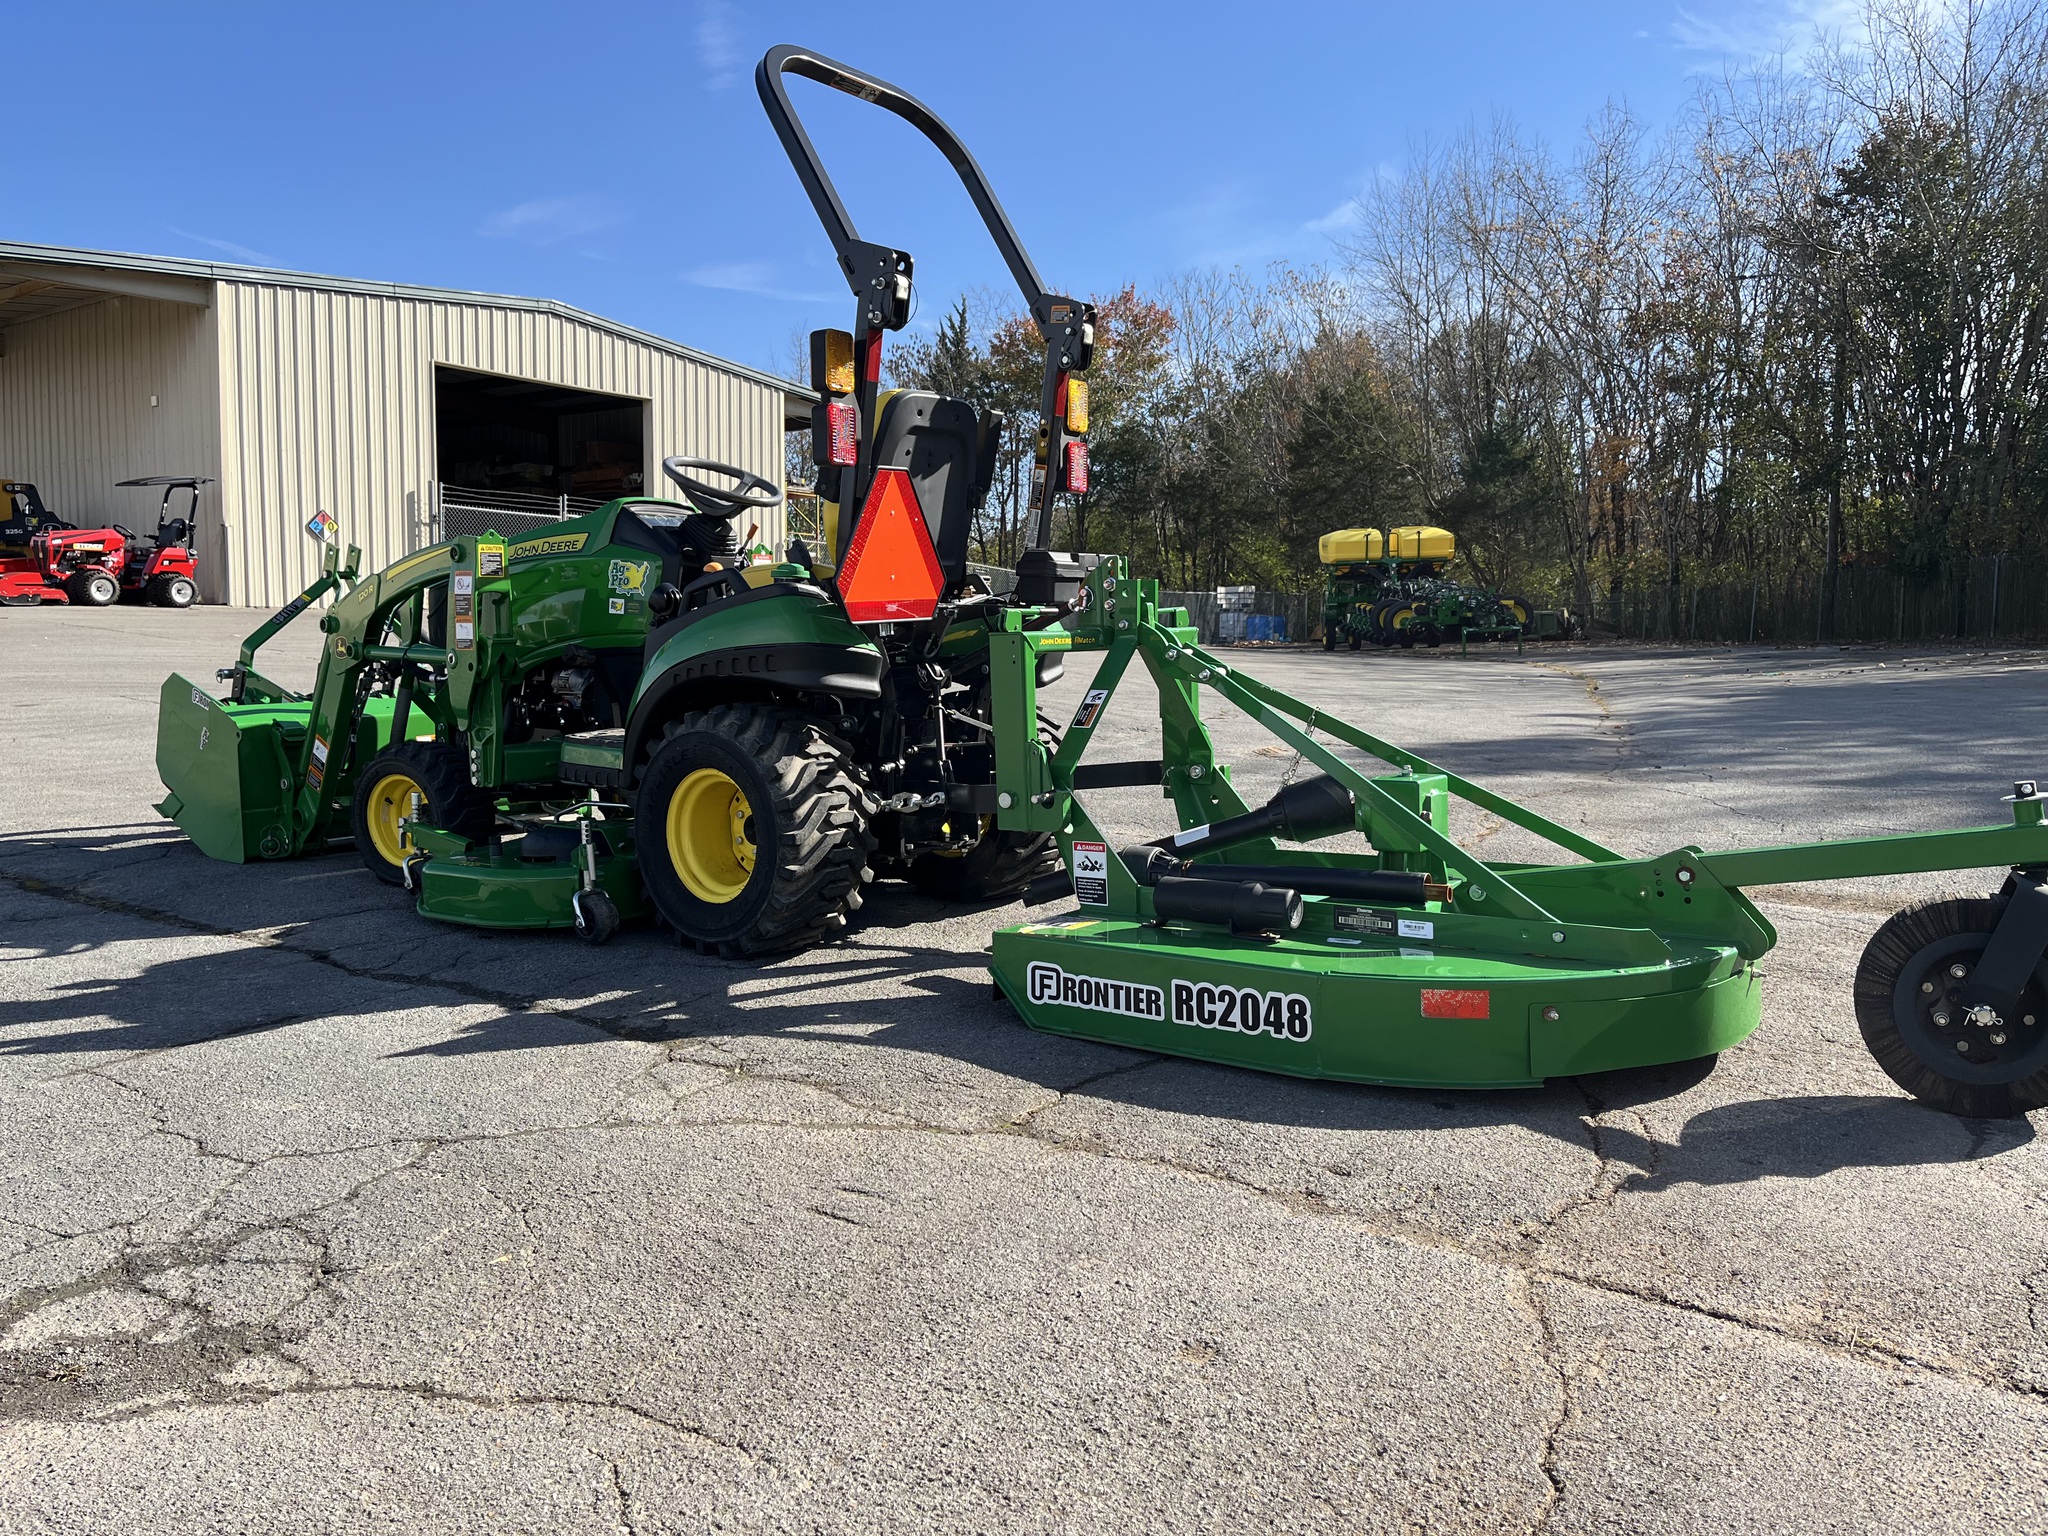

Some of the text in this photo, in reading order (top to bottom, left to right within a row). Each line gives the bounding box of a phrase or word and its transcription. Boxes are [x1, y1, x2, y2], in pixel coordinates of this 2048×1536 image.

[313, 520, 320, 531] 2
[509, 540, 579, 558] JOHN DEERE
[611, 562, 630, 576] Ag-
[611, 574, 630, 586] Pro
[1055, 637, 1072, 645] DEERE
[1081, 844, 1104, 852] DANGER
[1031, 965, 1309, 1040] FRONTIER RC2048
